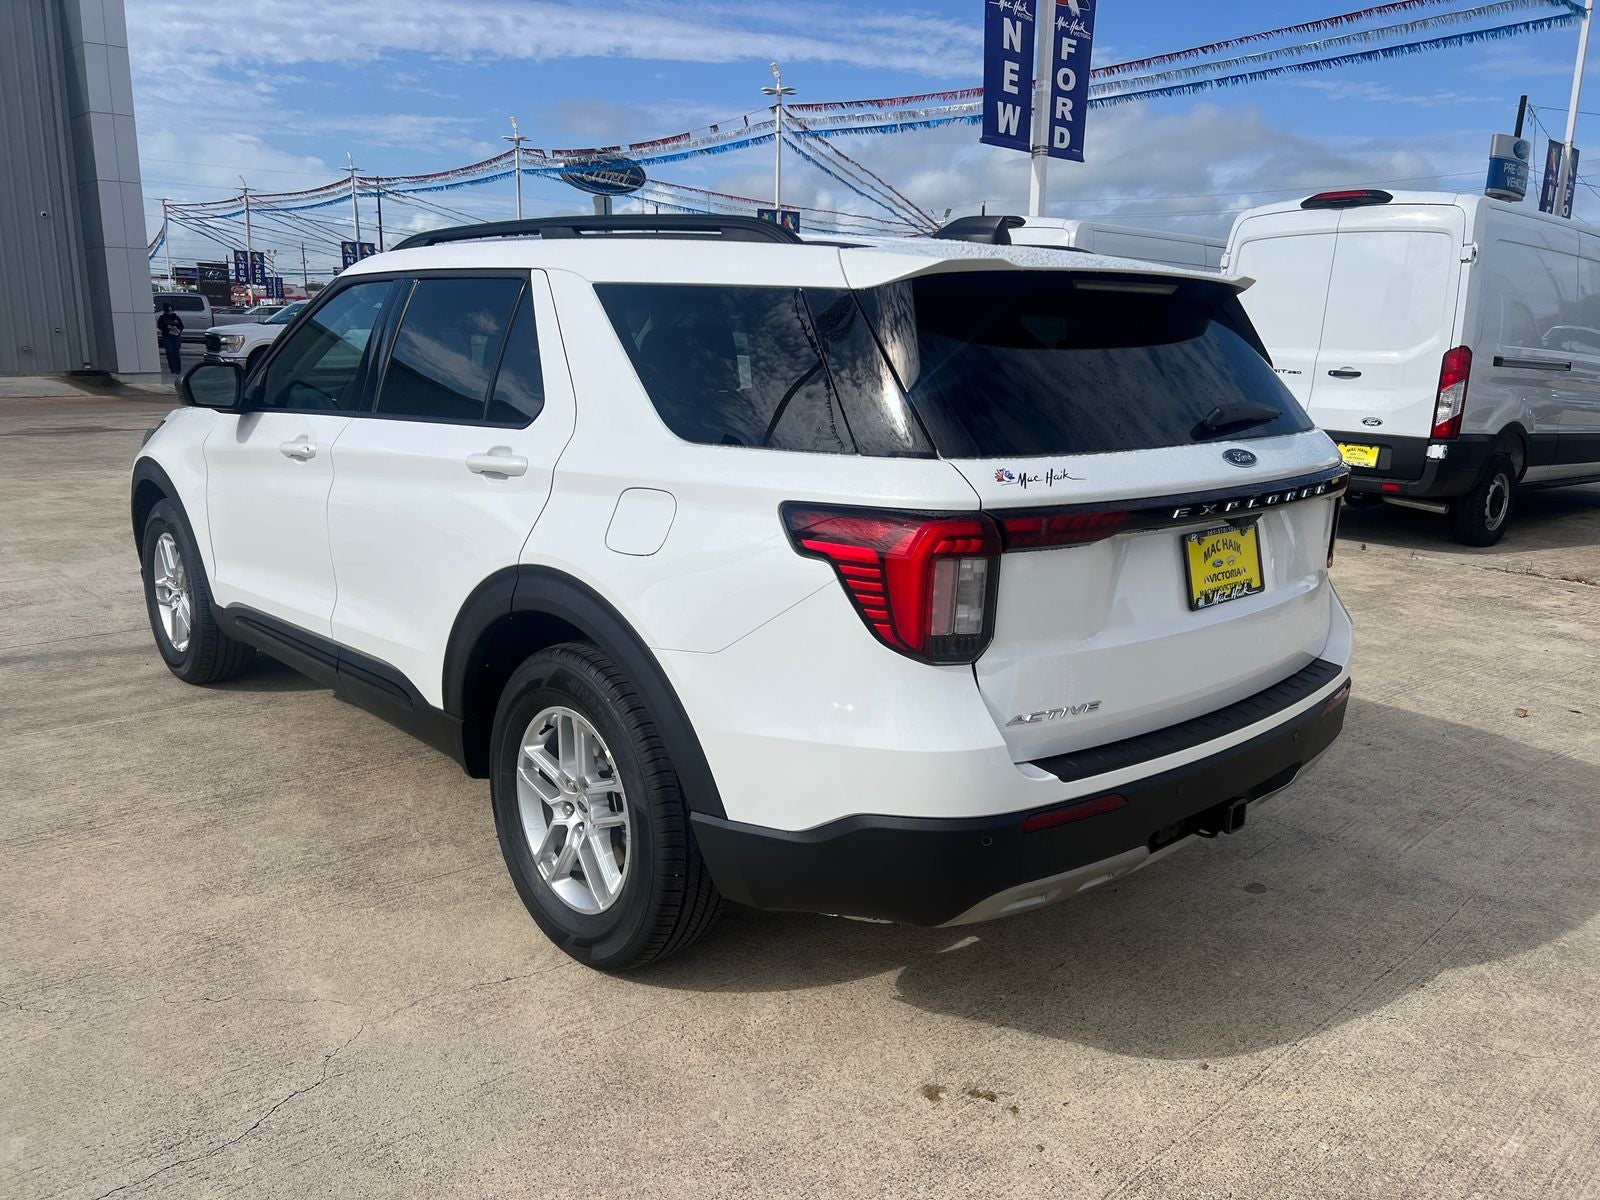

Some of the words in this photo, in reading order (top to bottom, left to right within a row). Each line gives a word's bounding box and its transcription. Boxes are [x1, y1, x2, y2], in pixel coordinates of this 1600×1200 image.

[997, 17, 1022, 136] NEW
[1053, 36, 1077, 150] FORD
[238, 263, 247, 282] NEW
[1001, 472, 1044, 490] Mac
[1045, 468, 1087, 487] Haik
[1173, 482, 1326, 519] EXPLORER
[1203, 539, 1221, 564] MAC
[1222, 538, 1243, 555] HAIK
[1209, 568, 1242, 583] VICTORIA
[1004, 700, 1103, 728] ACTIVE
